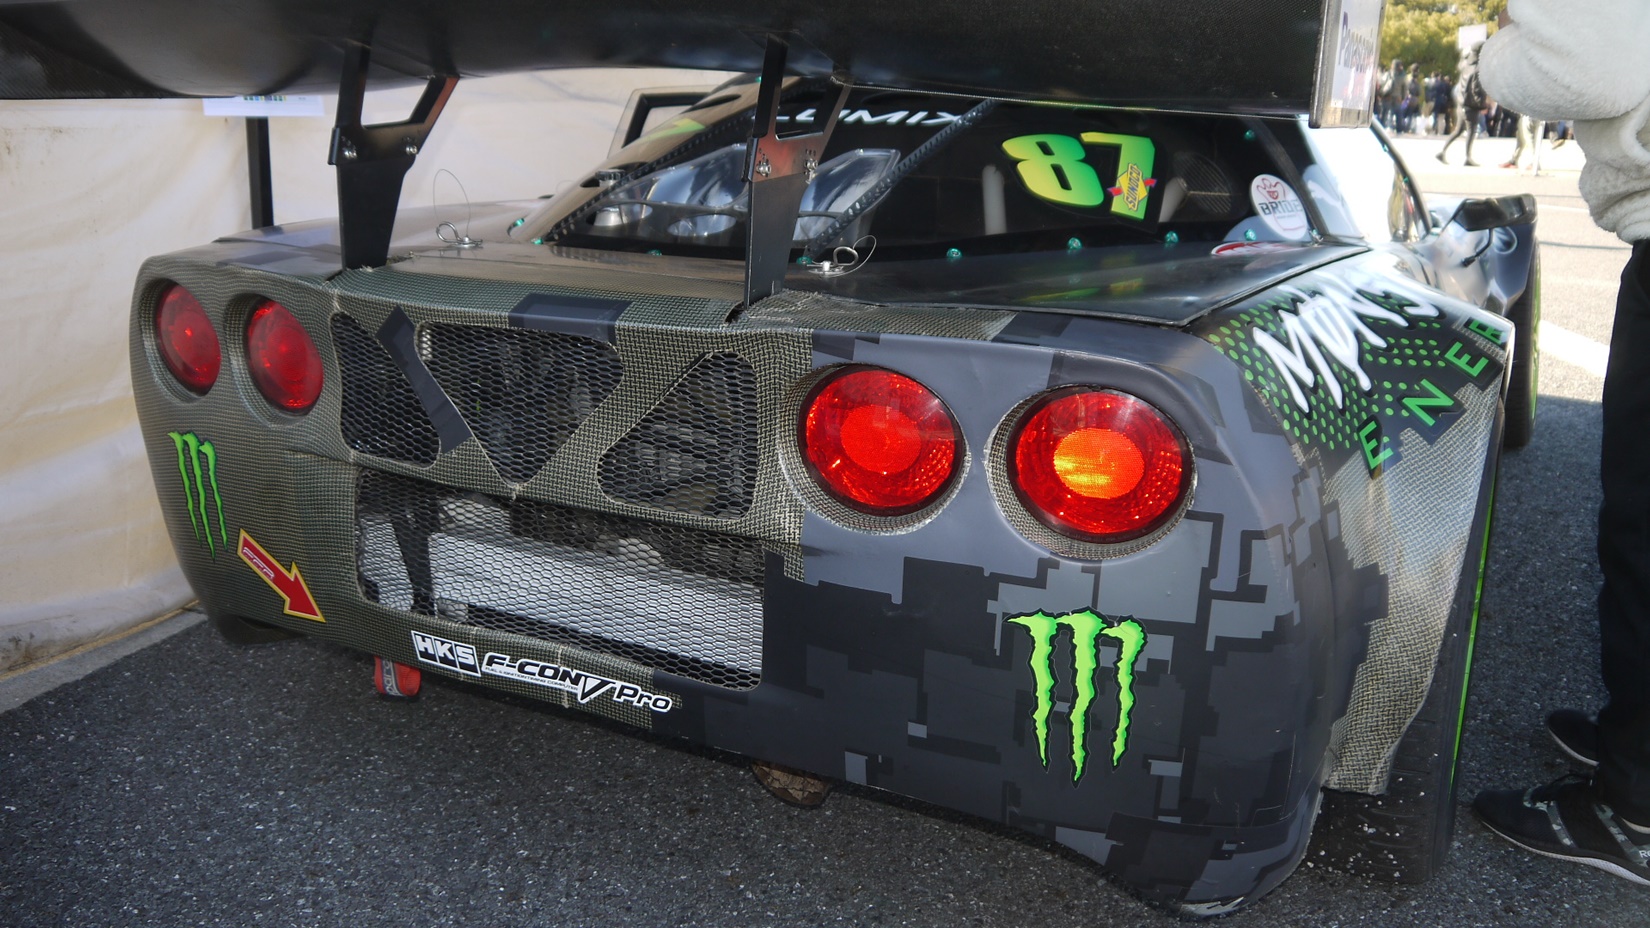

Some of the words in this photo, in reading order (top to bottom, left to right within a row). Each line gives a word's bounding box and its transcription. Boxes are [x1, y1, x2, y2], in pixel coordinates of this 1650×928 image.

[1002, 131, 1156, 220] 87
[1124, 165, 1142, 211] SUNOCO
[1259, 200, 1303, 216] BRIDE
[416, 635, 476, 665] HKS
[615, 686, 672, 711] Pro
